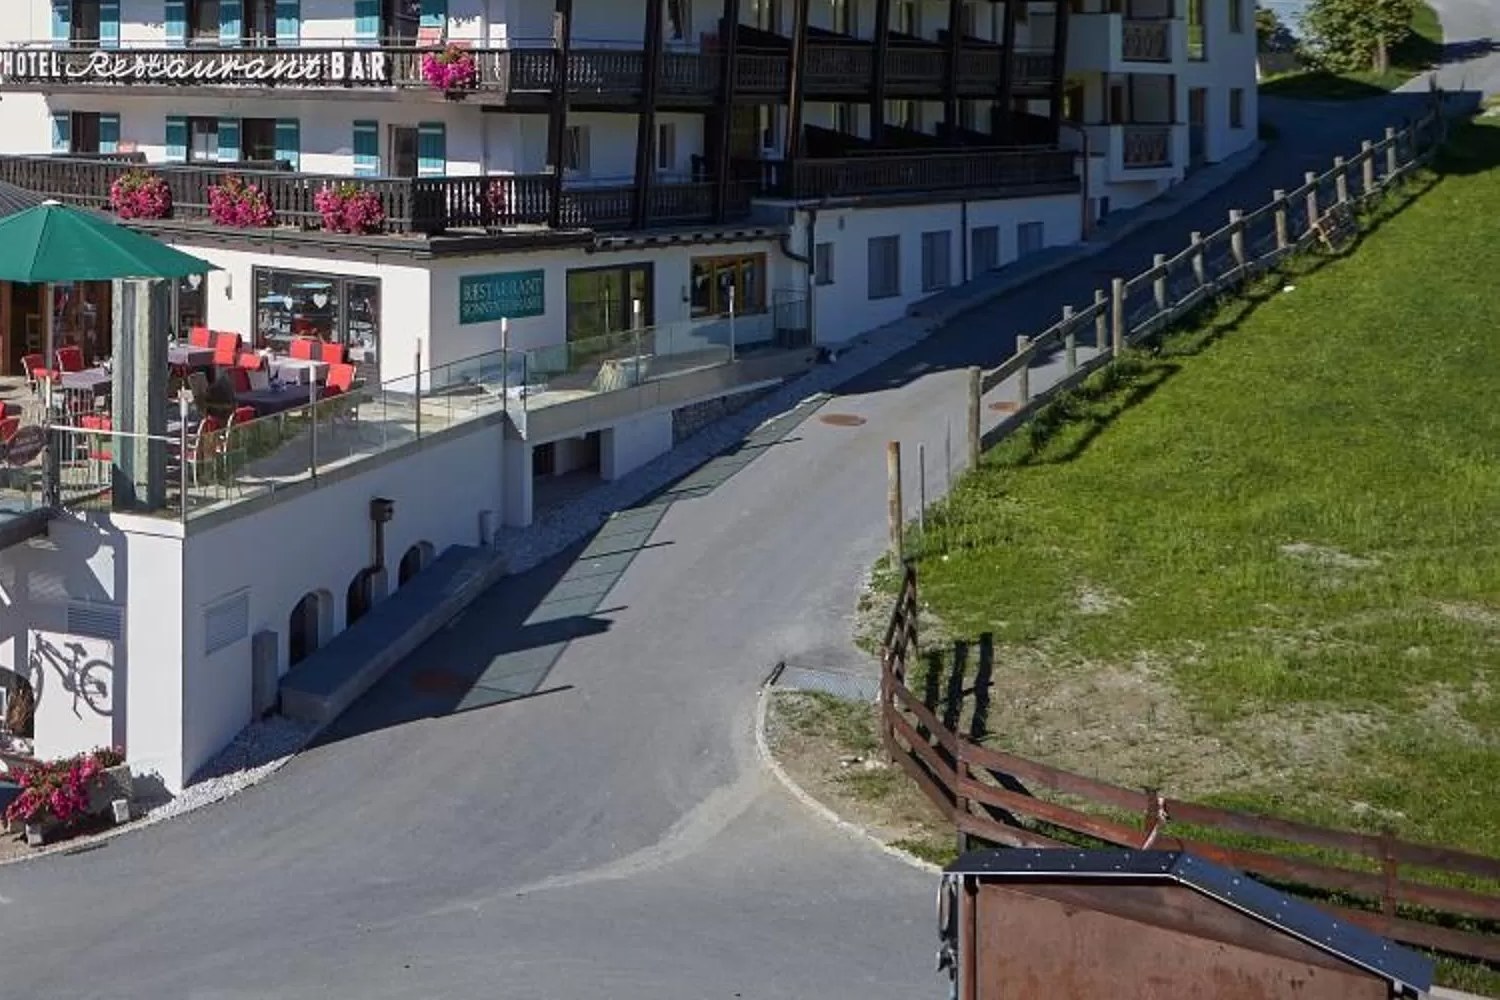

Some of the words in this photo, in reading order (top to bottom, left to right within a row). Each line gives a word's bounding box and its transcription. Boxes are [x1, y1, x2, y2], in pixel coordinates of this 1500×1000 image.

[3, 51, 60, 77] HOTEL
[65, 51, 322, 79] Restaurant
[331, 51, 386, 80] BAR
